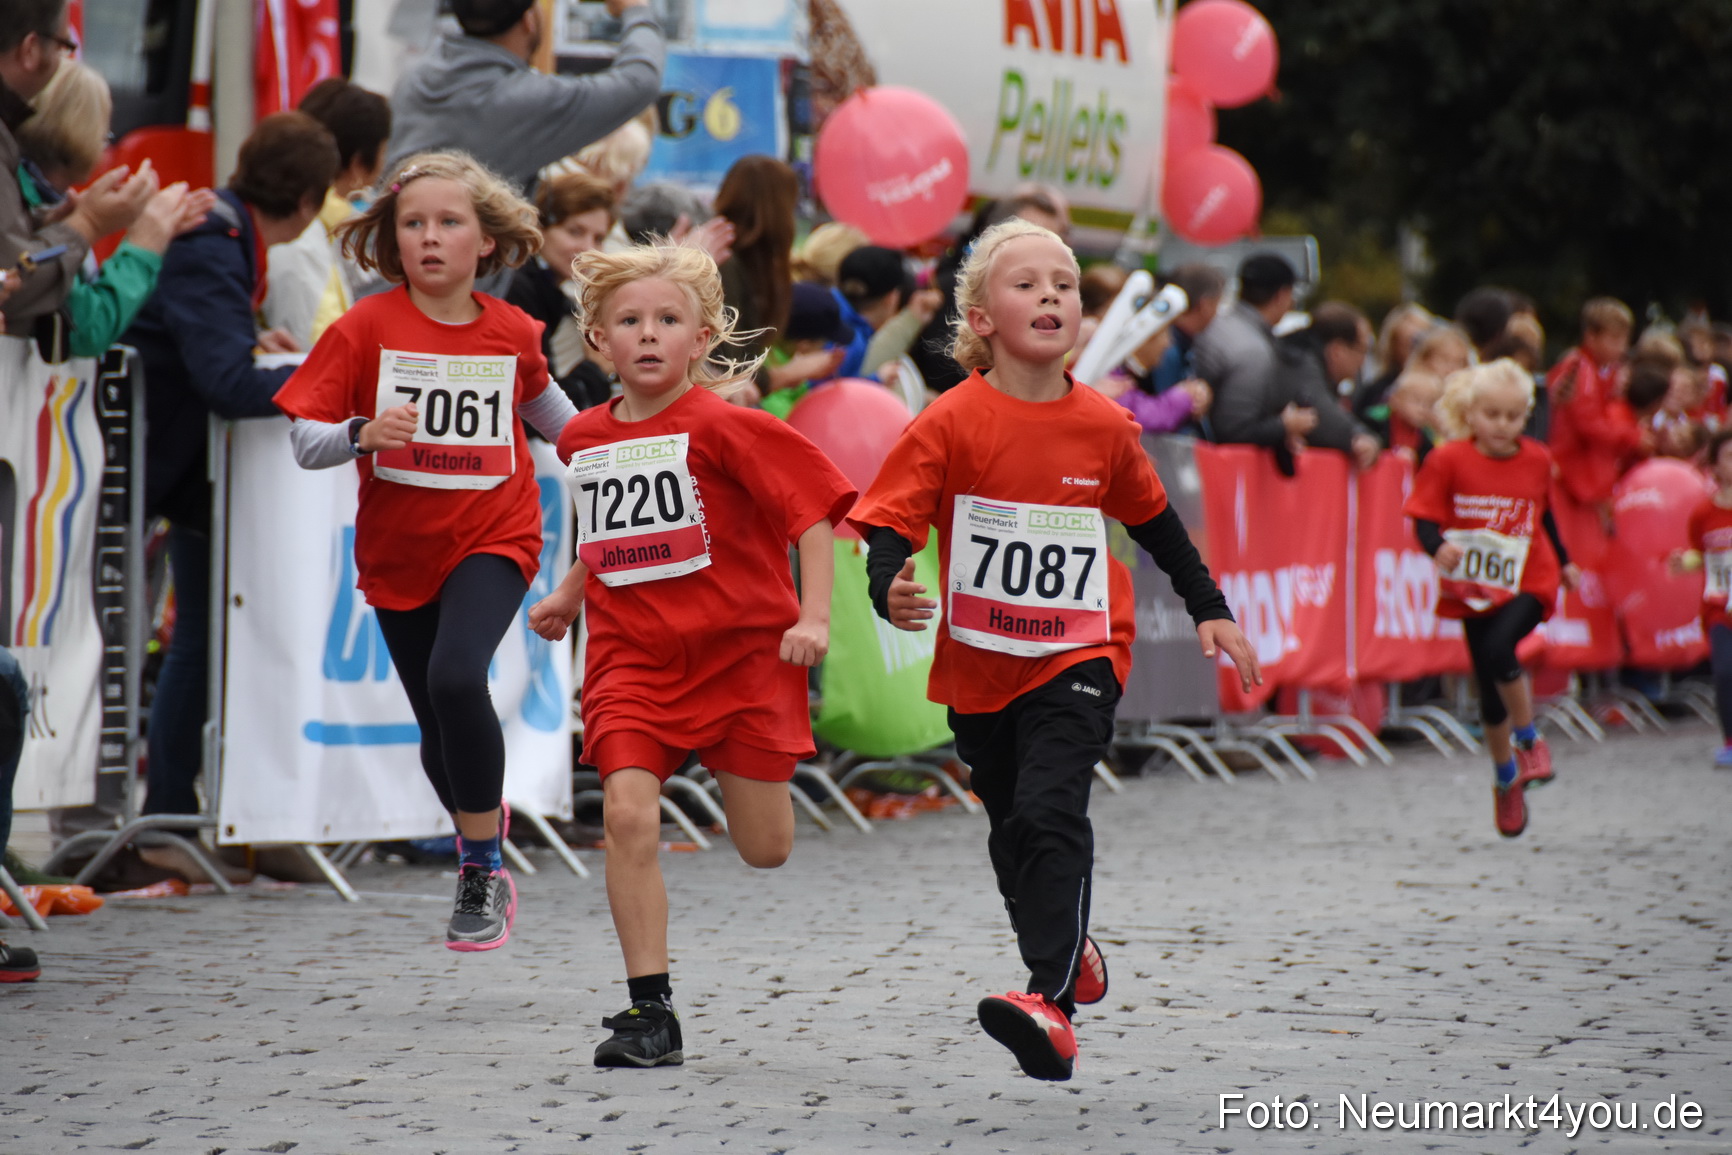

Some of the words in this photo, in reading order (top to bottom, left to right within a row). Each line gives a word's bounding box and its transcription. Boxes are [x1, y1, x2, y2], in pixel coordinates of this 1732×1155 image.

[1004, 0, 1130, 65] AVIA
[985, 68, 1127, 190] Pellets
[392, 366, 439, 378] NeuerMarkt
[447, 361, 506, 378] BOCK
[394, 385, 501, 438] 7061
[412, 448, 483, 471] Victoria
[616, 441, 677, 464] BOCK
[573, 461, 610, 474] NeuerMarkt
[1062, 476, 1073, 485] FC
[580, 470, 685, 533] 7220
[689, 513, 697, 523] K
[968, 512, 1018, 529] NeuerMarkt
[1028, 509, 1097, 532] BOCK
[600, 542, 672, 569] Johanna
[970, 533, 1097, 601] 7087
[1465, 548, 1515, 586] 060
[956, 581, 962, 592] 3
[1096, 598, 1103, 609] K
[988, 606, 1066, 638] Hannah
[1081, 685, 1102, 697] JAKO
